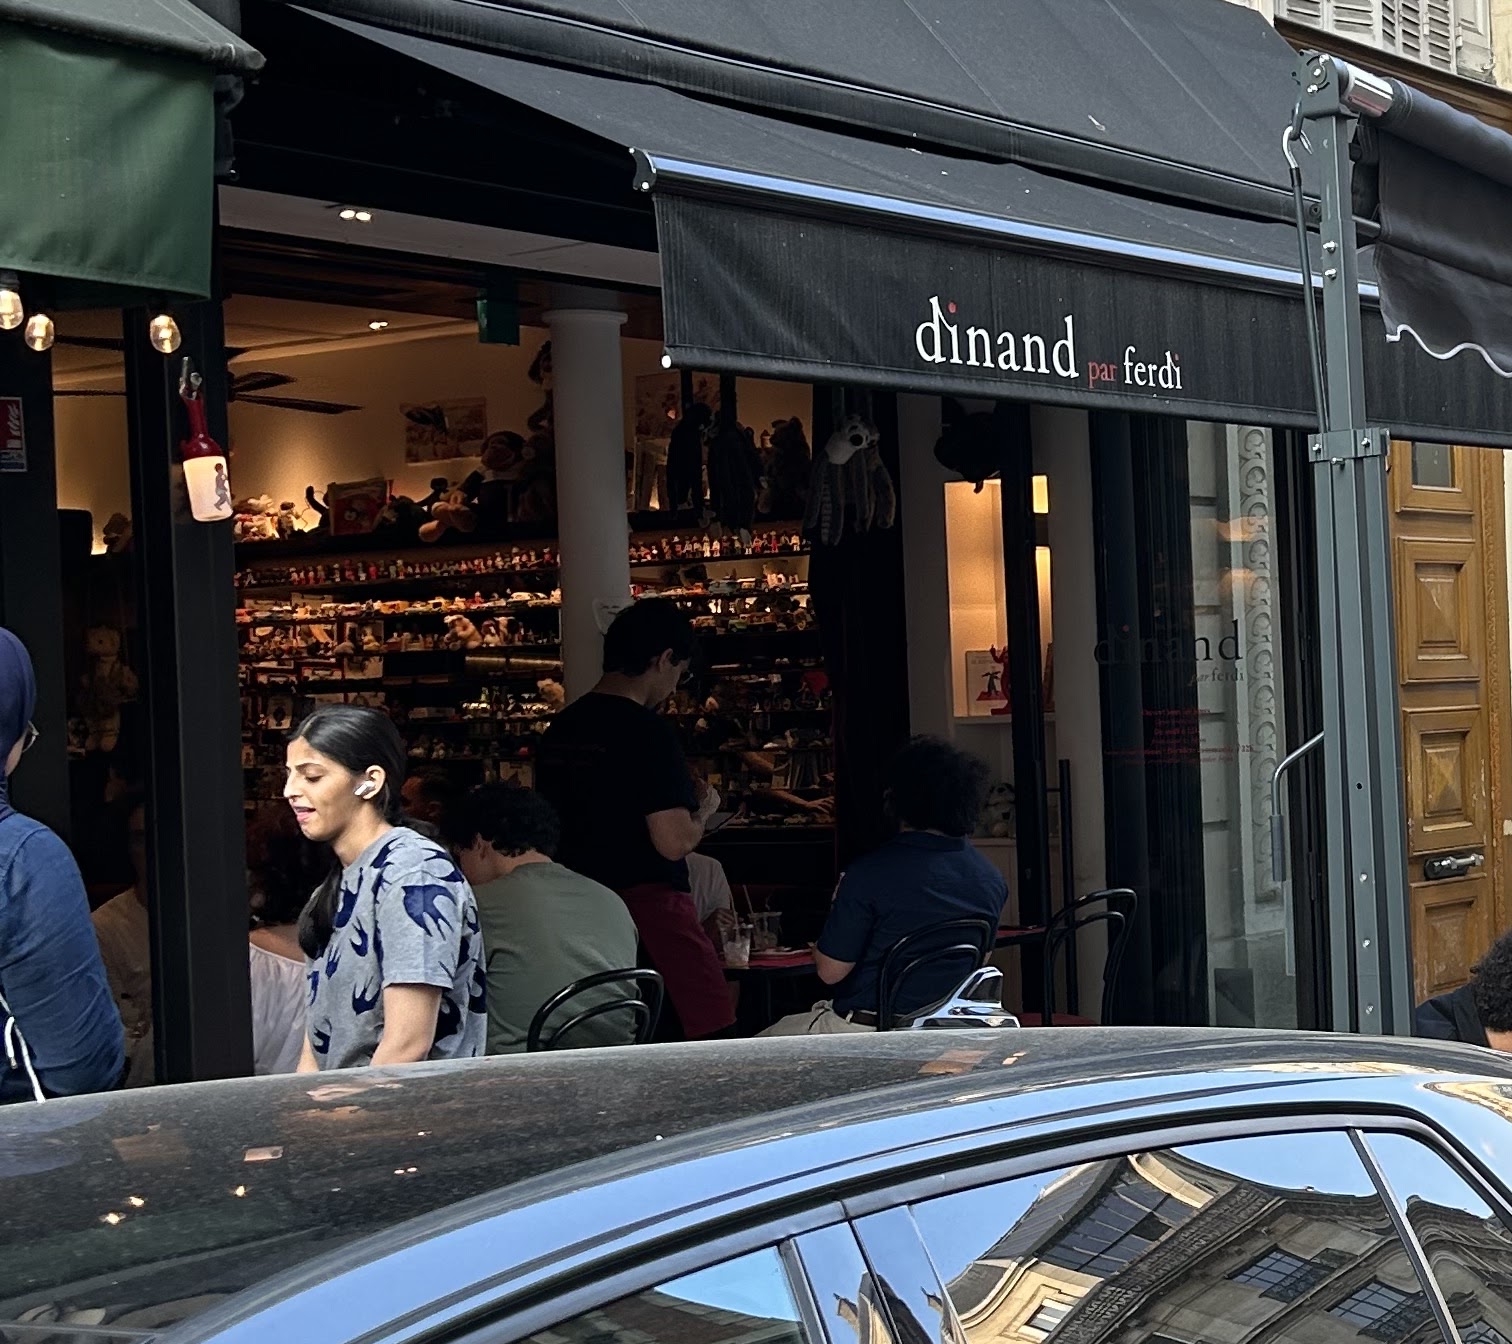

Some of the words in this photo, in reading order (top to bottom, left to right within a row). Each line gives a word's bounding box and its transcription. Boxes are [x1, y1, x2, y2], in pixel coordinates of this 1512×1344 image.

[915, 295, 1079, 379] dinand
[1088, 360, 1118, 389] par
[1123, 345, 1183, 390] ferdi
[1093, 618, 1243, 665] dinand
[1211, 667, 1244, 683] ferdi
